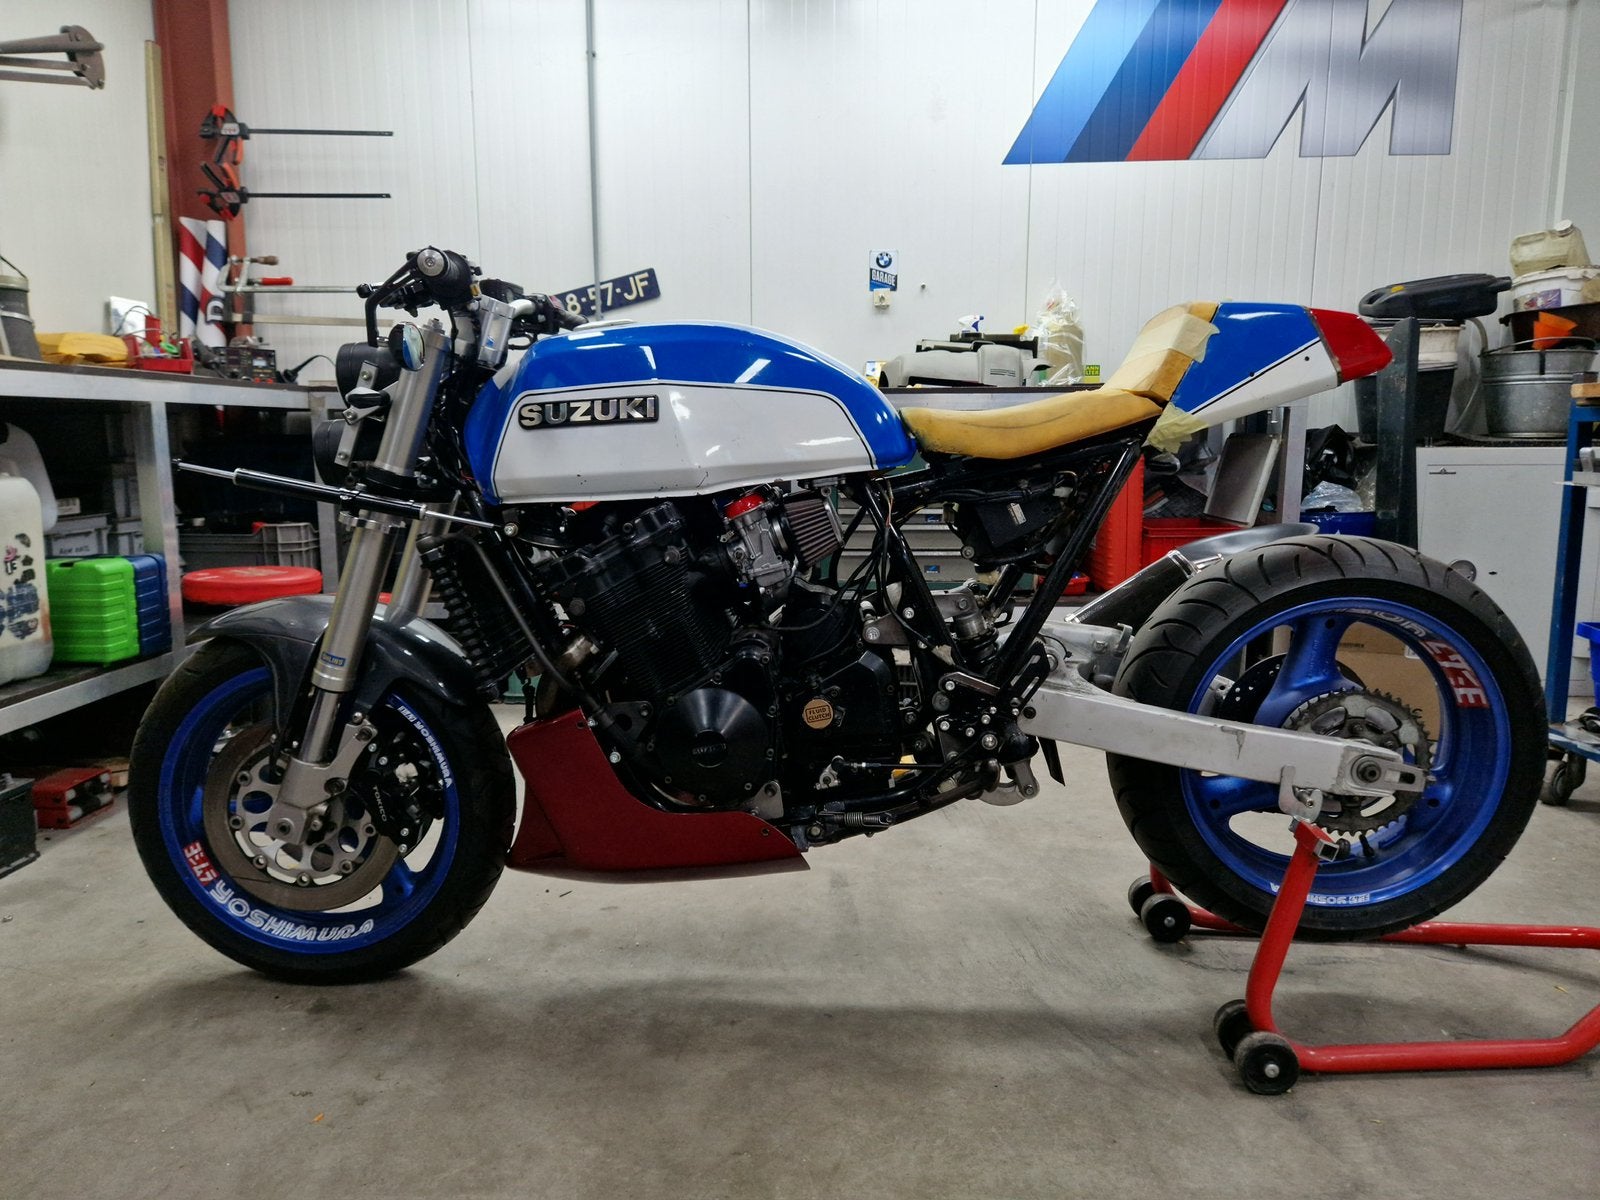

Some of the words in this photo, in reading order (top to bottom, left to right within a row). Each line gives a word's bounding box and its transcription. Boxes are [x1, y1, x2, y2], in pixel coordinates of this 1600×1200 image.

[871, 269, 897, 287] GARAGE
[519, 397, 656, 427] SUZUKI
[808, 707, 827, 715] FLUID
[808, 712, 831, 721] CLUTCH
[413, 721, 453, 788] YOSHIMURA
[373, 785, 388, 822] TOKICO
[209, 879, 375, 942] YOSHIMURA
